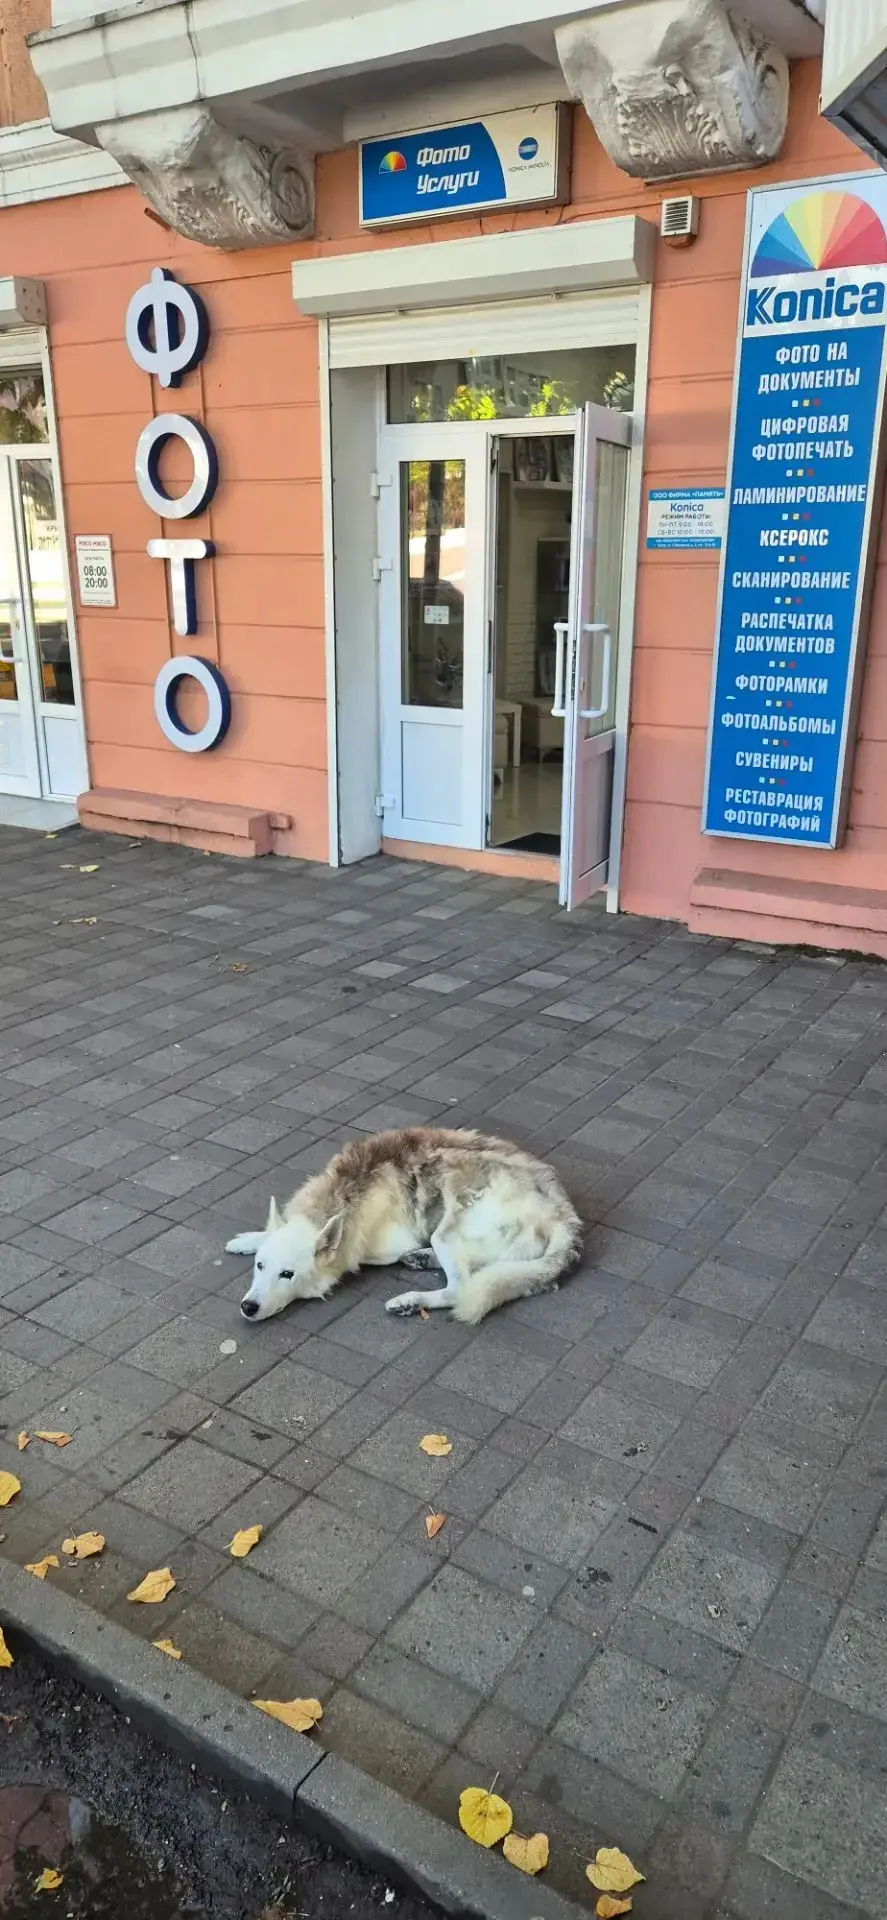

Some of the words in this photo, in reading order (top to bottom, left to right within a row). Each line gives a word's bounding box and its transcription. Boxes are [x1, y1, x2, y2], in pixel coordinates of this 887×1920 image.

[416, 144, 471, 167] Фото
[416, 170, 480, 195] Услуги
[746, 277, 885, 326] Konica
[775, 344, 821, 365] ФОТО
[826, 341, 848, 361] НА
[757, 367, 861, 395] ДОКУМЕНТЫ
[760, 414, 849, 439] ЦИФРОВАЯ
[751, 440, 854, 461] ФОТОПЕЧАТЬ
[732, 484, 867, 506] ЛАМИНИРОВАНИЕ
[125, 266, 230, 753] ФОТО
[670, 502, 704, 512] Konica
[759, 528, 830, 547] КСЕРОКС
[83, 565, 107, 577] 08:00
[732, 571, 851, 589] СКАНИРОВАНИЕ
[85, 577, 108, 588] 20:00
[741, 612, 833, 631] РАСПЕЧАТКА
[735, 635, 835, 654] ДОКУМЕНТОВ
[735, 674, 828, 694] ФОТОРАМКИ
[721, 712, 836, 735] ФОТОАЛЬБОМЫ
[735, 751, 814, 772] СУВЕНИРЫ
[725, 787, 823, 811] РЕСТАВРАЦИЯ
[724, 809, 821, 833] ФОТОГРАФИЙ
